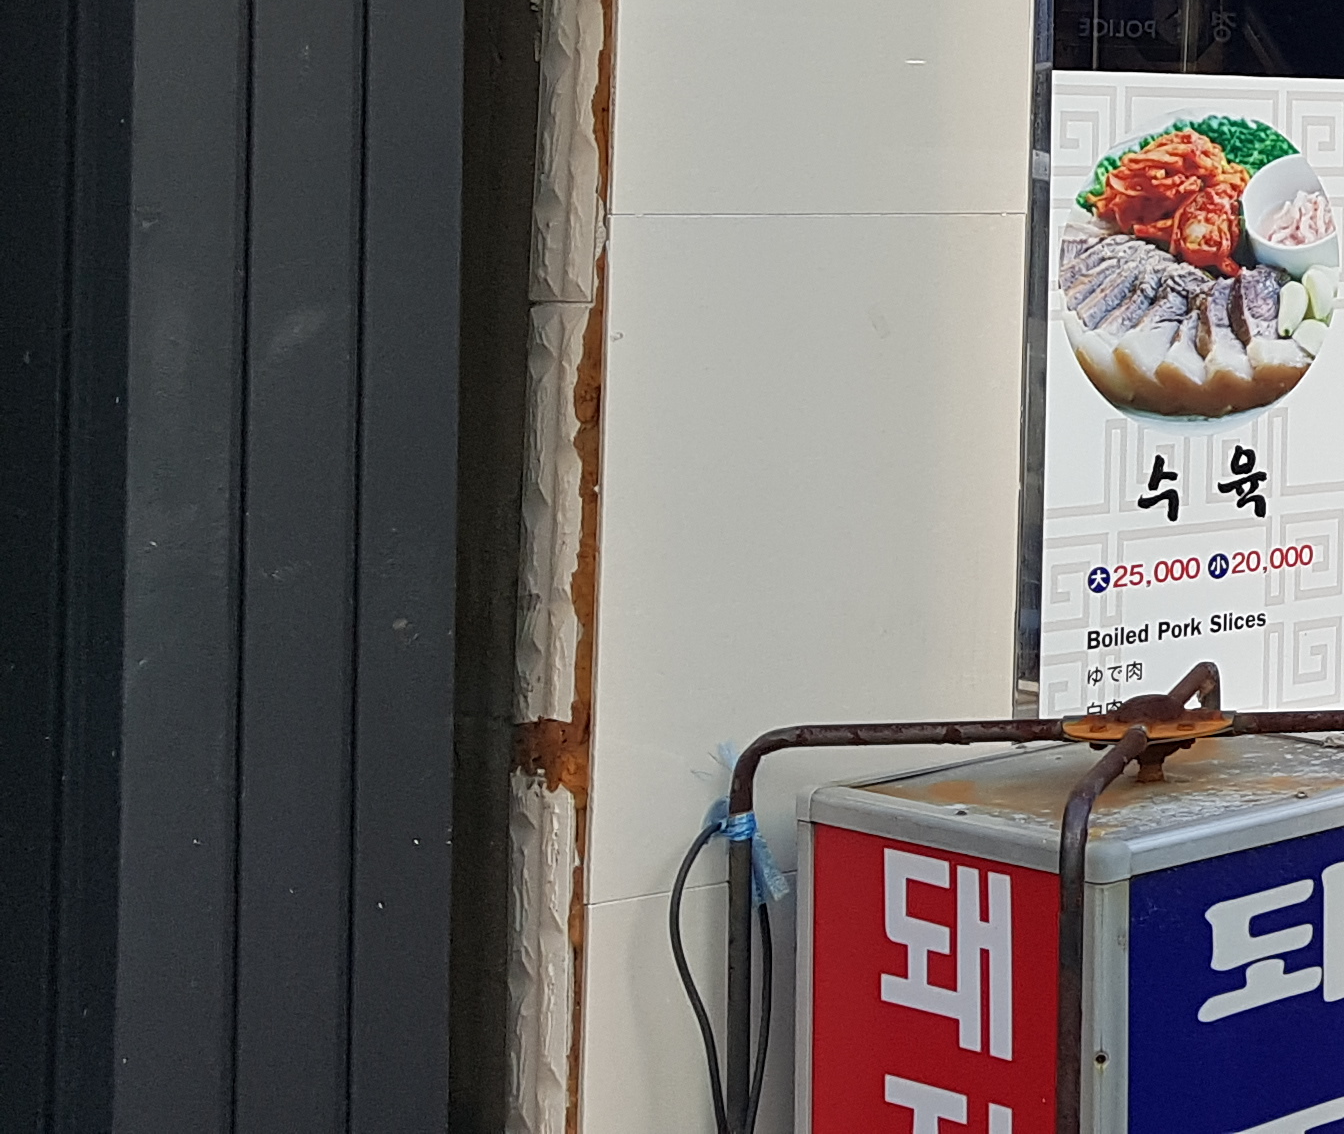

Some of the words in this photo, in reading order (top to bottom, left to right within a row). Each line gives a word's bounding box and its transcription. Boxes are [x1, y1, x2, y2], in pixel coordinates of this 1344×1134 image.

[1112, 557, 1202, 590] 25,000
[1231, 544, 1314, 576] 20,000
[1087, 622, 1150, 651] Boiled
[1157, 616, 1203, 641] Pork
[1209, 609, 1267, 634] Slices
[1087, 661, 1143, 686] ゆで肉
